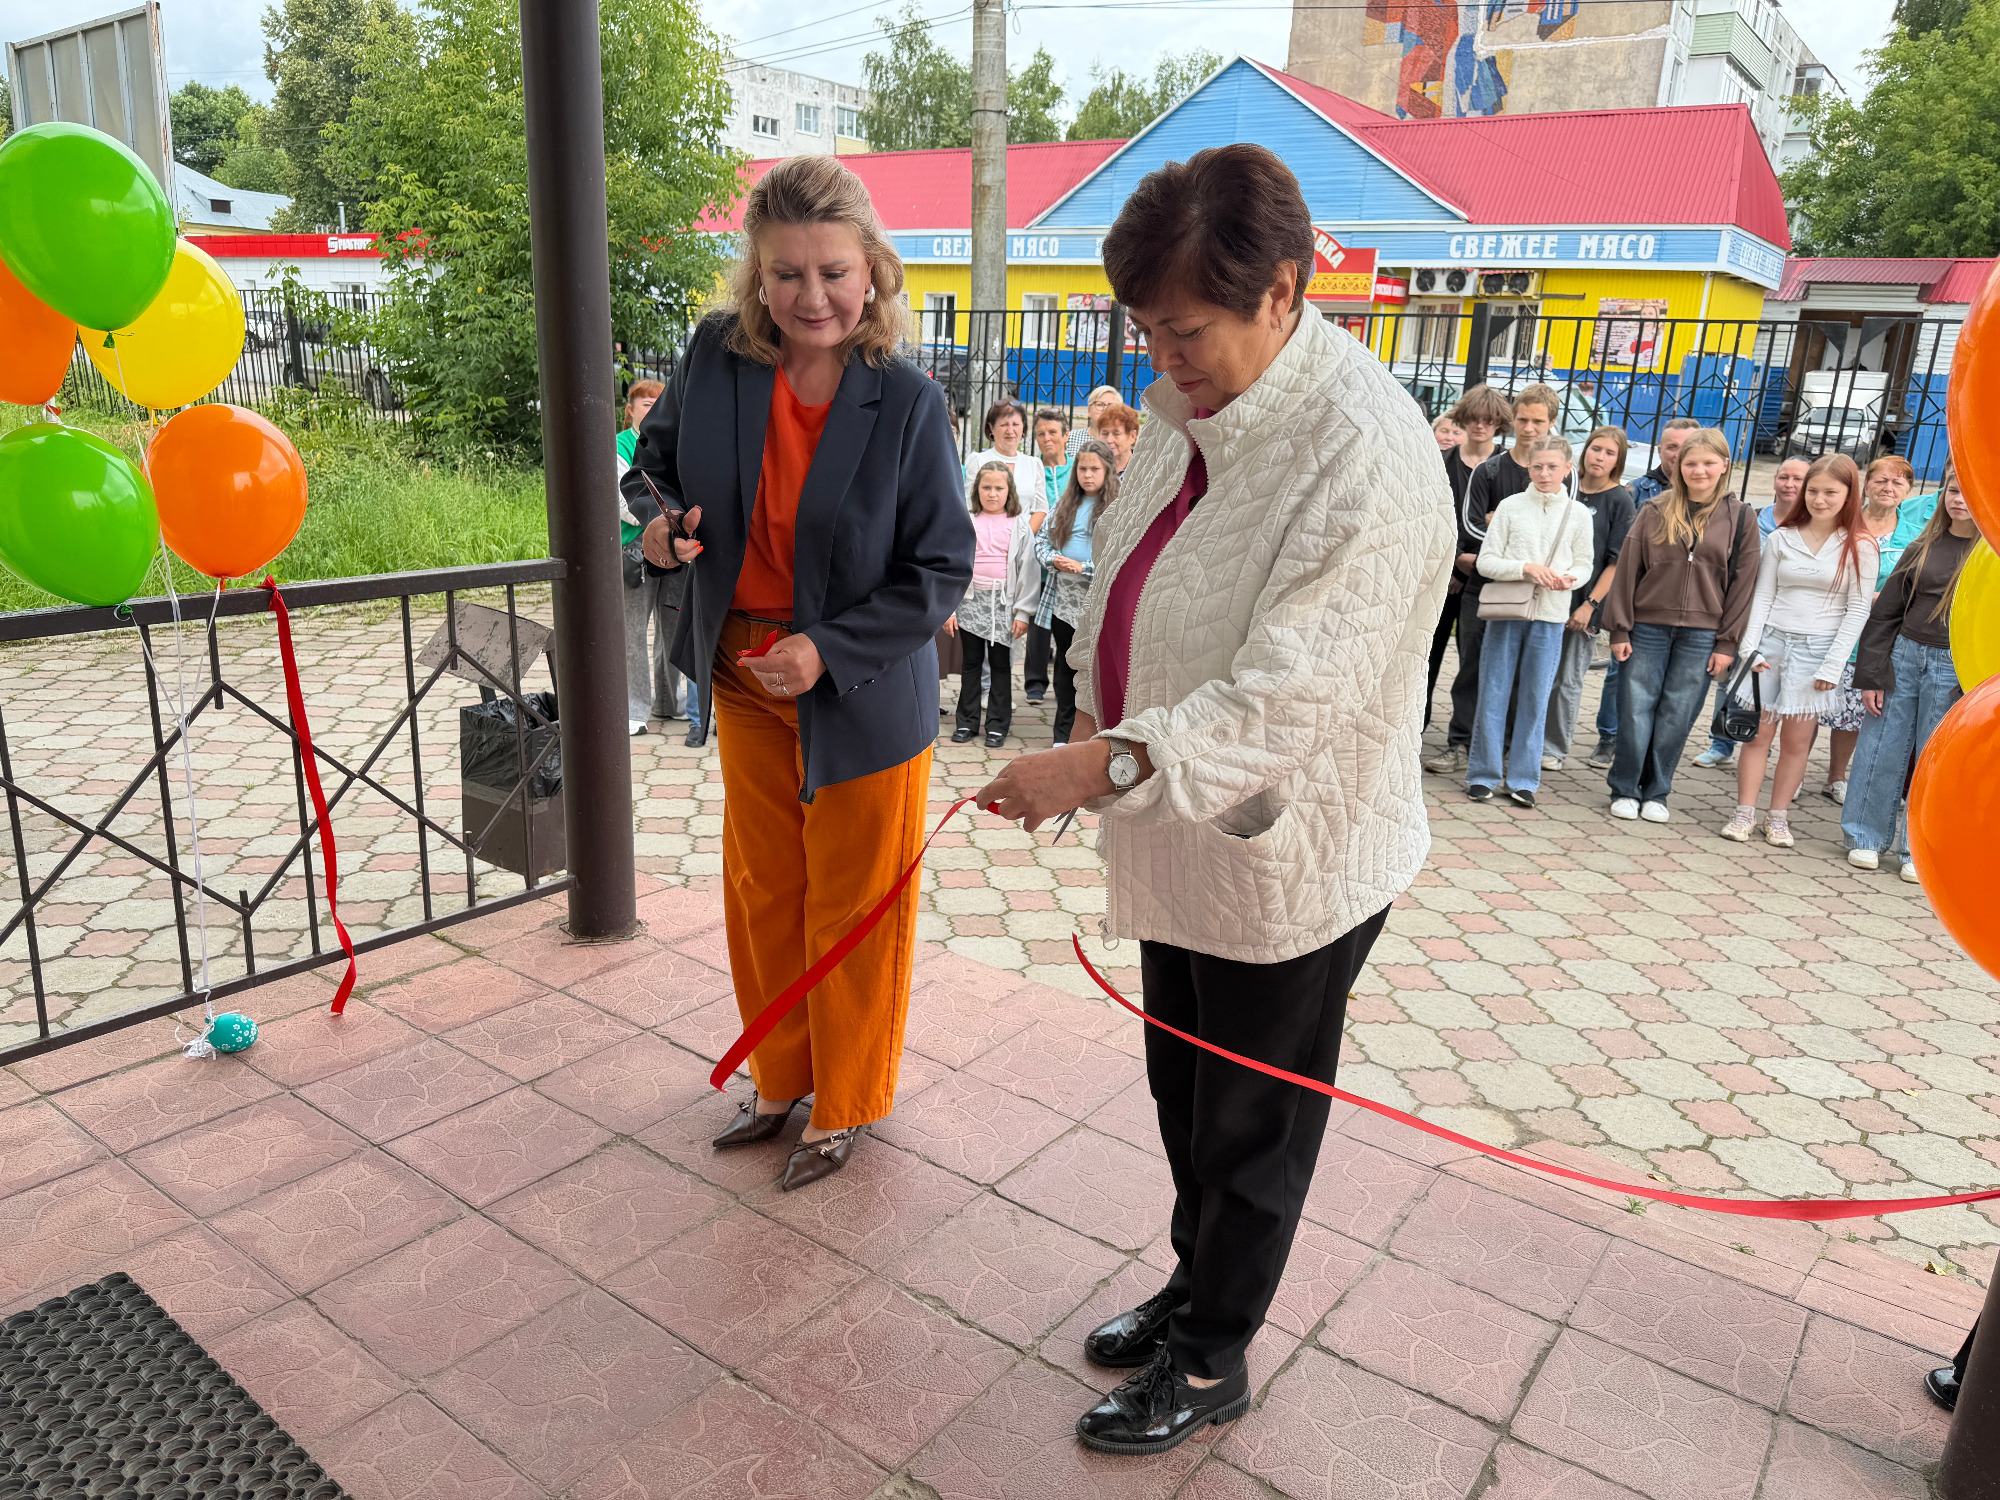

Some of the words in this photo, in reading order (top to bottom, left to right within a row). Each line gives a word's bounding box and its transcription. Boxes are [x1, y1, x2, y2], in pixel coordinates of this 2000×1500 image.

[1012, 237, 1059, 257] МЯСО
[1449, 235, 1558, 259] СВЕЖЕЕ
[1577, 234, 1655, 259] МЯСО
